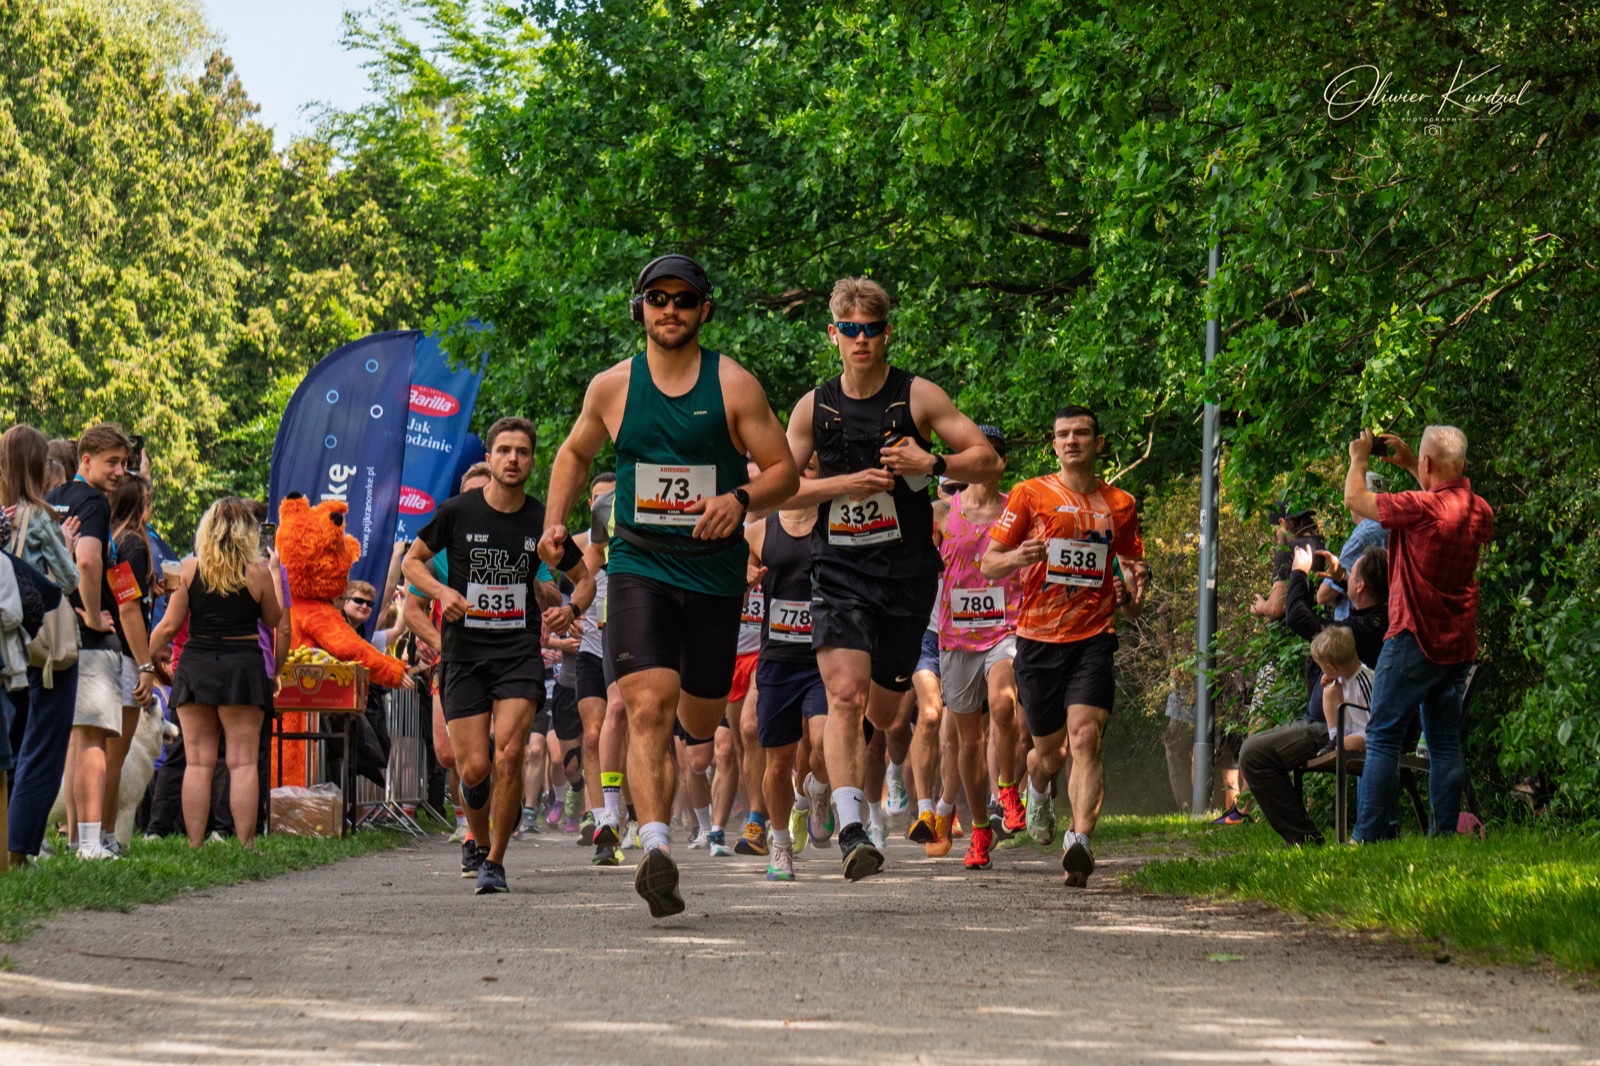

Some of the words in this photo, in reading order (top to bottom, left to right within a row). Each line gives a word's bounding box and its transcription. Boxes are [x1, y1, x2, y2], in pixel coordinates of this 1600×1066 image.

[658, 477, 690, 501] 73
[361, 466, 376, 557] www.pijkranowke.pl
[840, 500, 879, 525] 332
[470, 547, 530, 571] SIŁA
[1060, 549, 1097, 568] 538
[478, 593, 515, 610] 635
[960, 595, 995, 611] 780
[780, 608, 811, 625] 778
